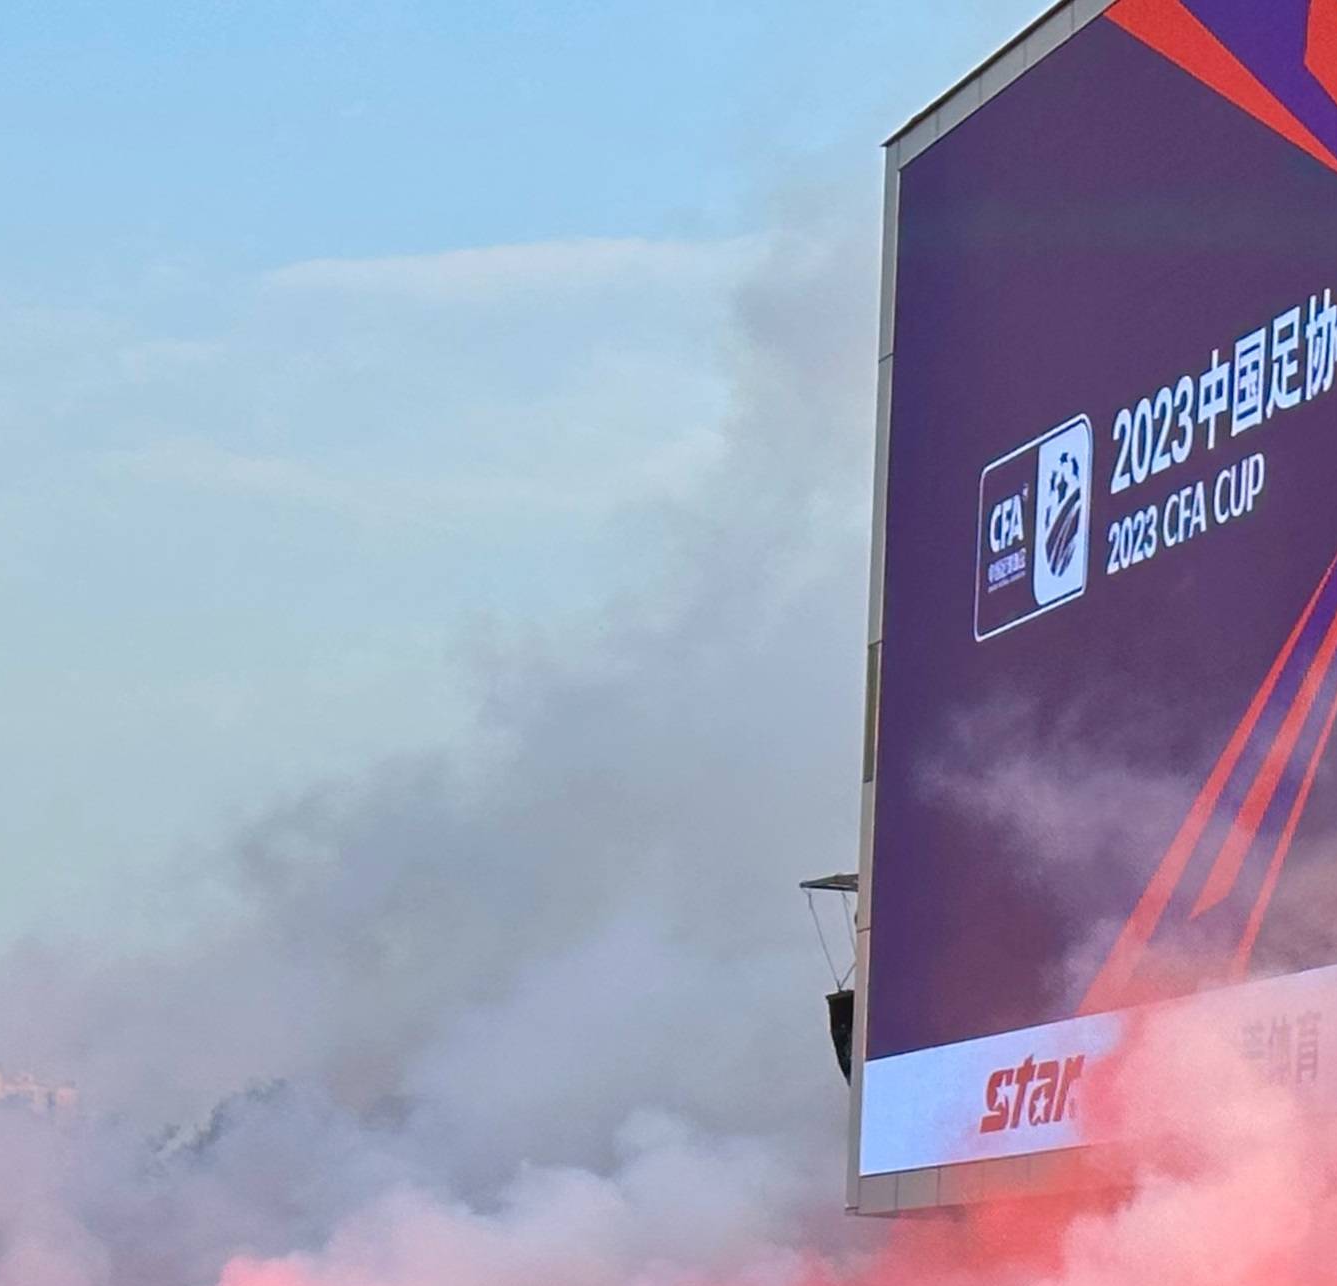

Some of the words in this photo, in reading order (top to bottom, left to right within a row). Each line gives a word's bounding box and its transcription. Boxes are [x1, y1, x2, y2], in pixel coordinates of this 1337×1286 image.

[989, 494, 1024, 553] CFA
[1107, 505, 1159, 576] 2023
[1163, 480, 1207, 548] CFA
[1213, 452, 1265, 525] CUP
[980, 1053, 1084, 1134] star
